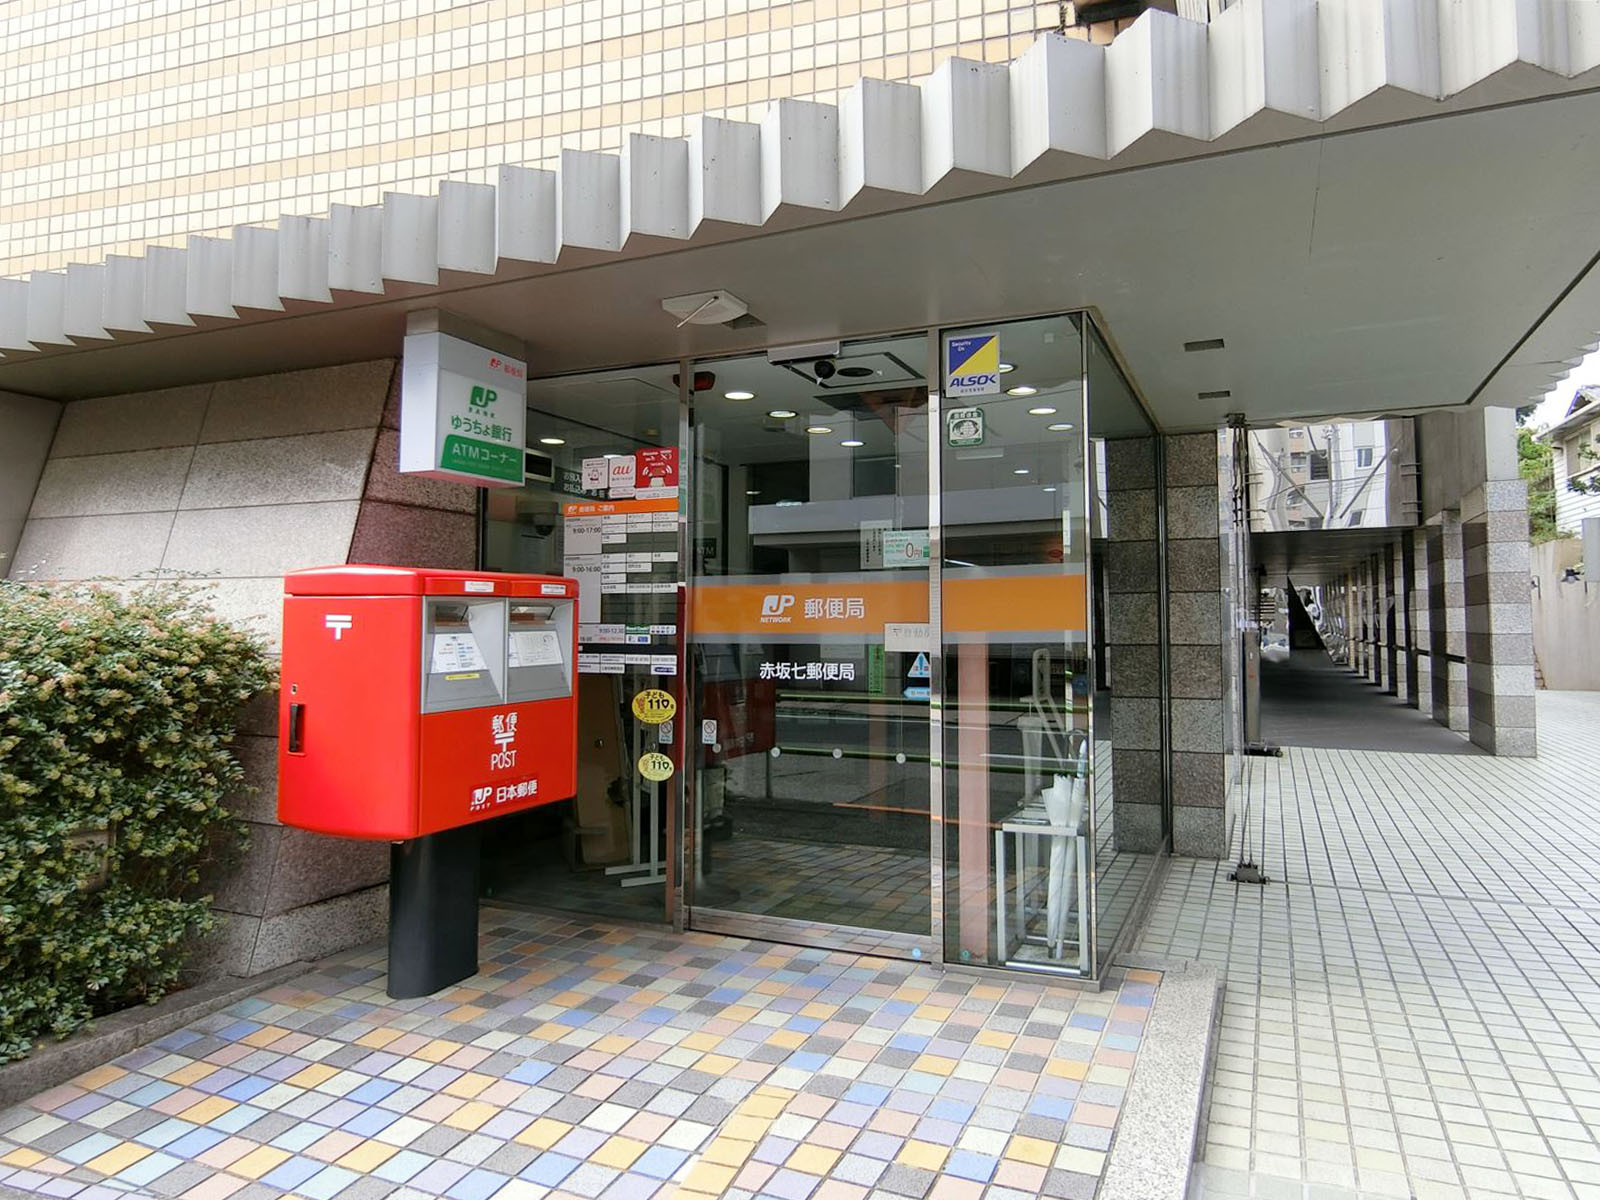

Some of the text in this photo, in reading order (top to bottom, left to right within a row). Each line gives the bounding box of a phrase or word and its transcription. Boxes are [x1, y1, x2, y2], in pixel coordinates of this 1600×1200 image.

[950, 375, 996, 387] ALSOK
[451, 415, 513, 442] ゆうちょ銀行
[452, 443, 517, 464] ATMコーナー
[613, 466, 632, 475] au
[804, 598, 865, 619] 郵便局
[760, 662, 855, 681] 赤坂七郵便局
[645, 691, 665, 699] 子ども
[492, 712, 518, 735] 郵便
[491, 750, 518, 771] POST
[496, 779, 537, 803] 日本郵便
